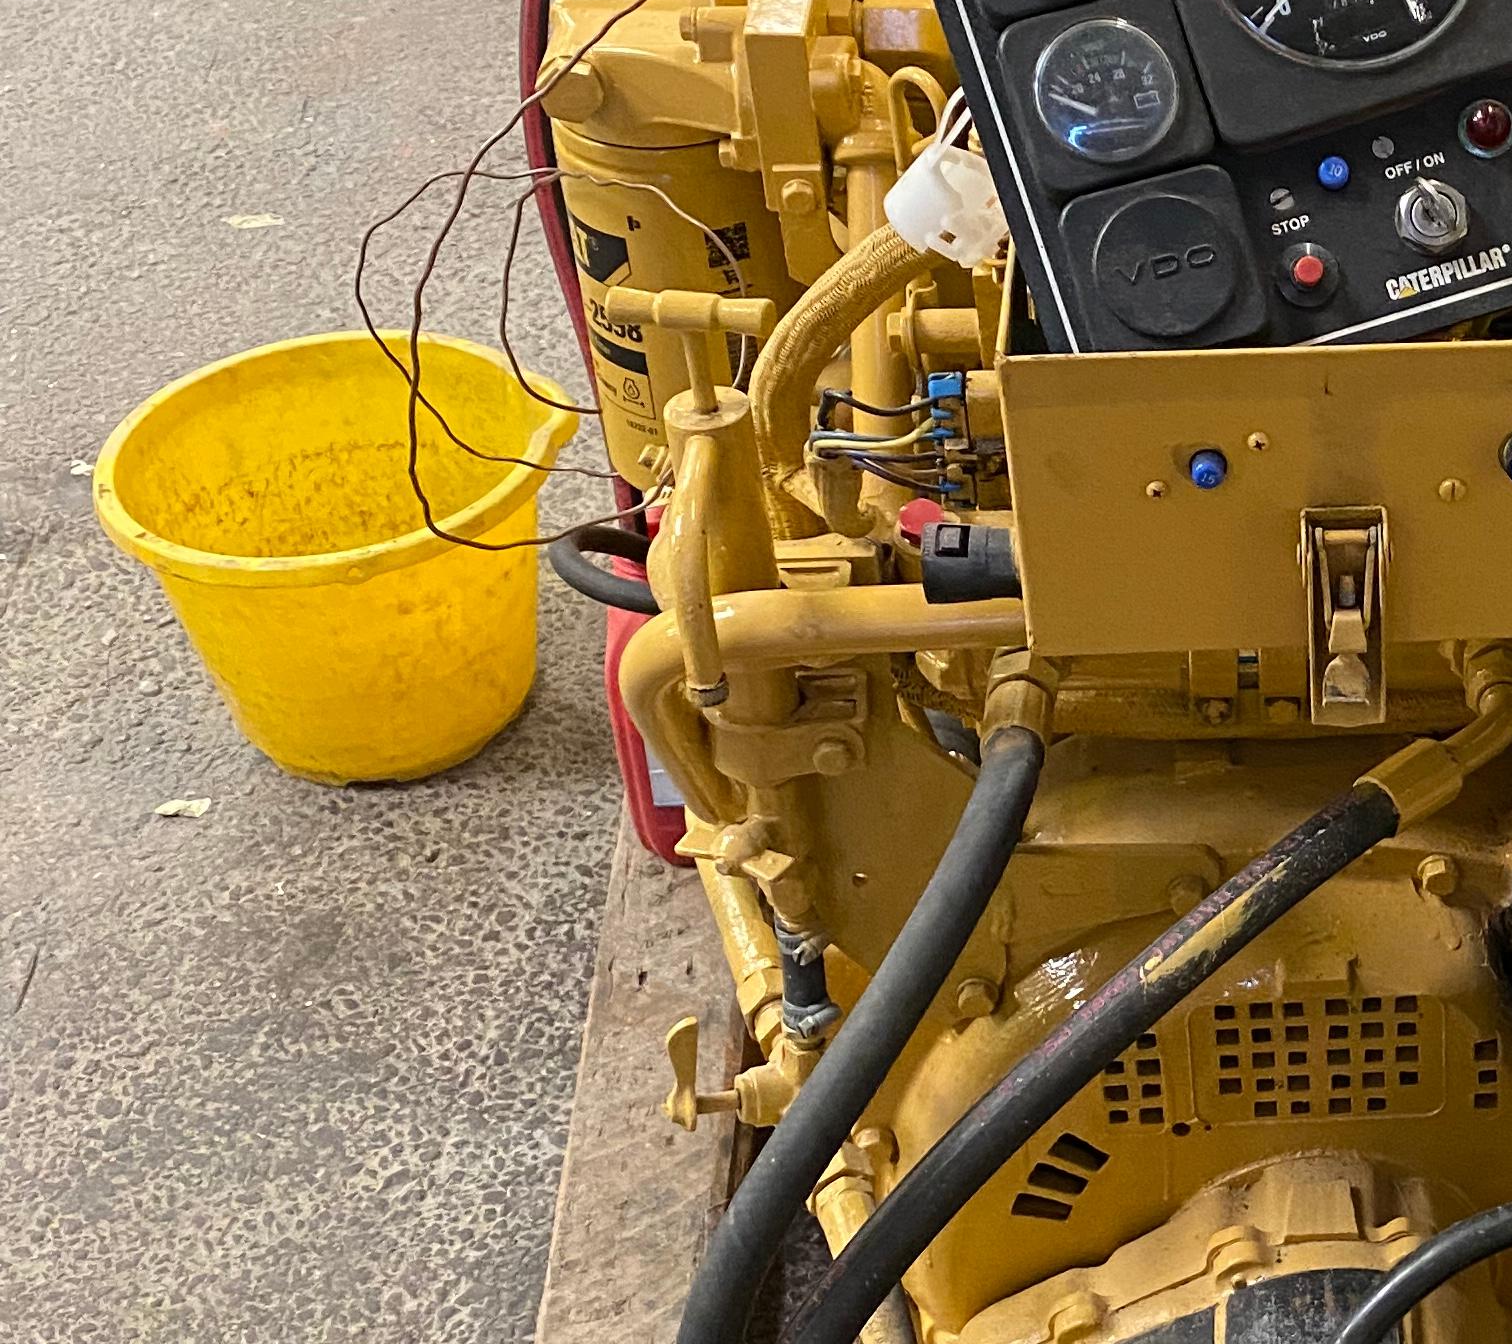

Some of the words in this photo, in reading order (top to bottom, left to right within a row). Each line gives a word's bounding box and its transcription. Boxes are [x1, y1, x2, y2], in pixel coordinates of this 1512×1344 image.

[1362, 30, 1388, 43] VDO
[1385, 160, 1413, 180] OFF
[1423, 152, 1446, 168] ON
[1271, 214, 1310, 236] STOP
[1113, 243, 1217, 286] VDO
[1385, 246, 1509, 301] CATERPILLAR
